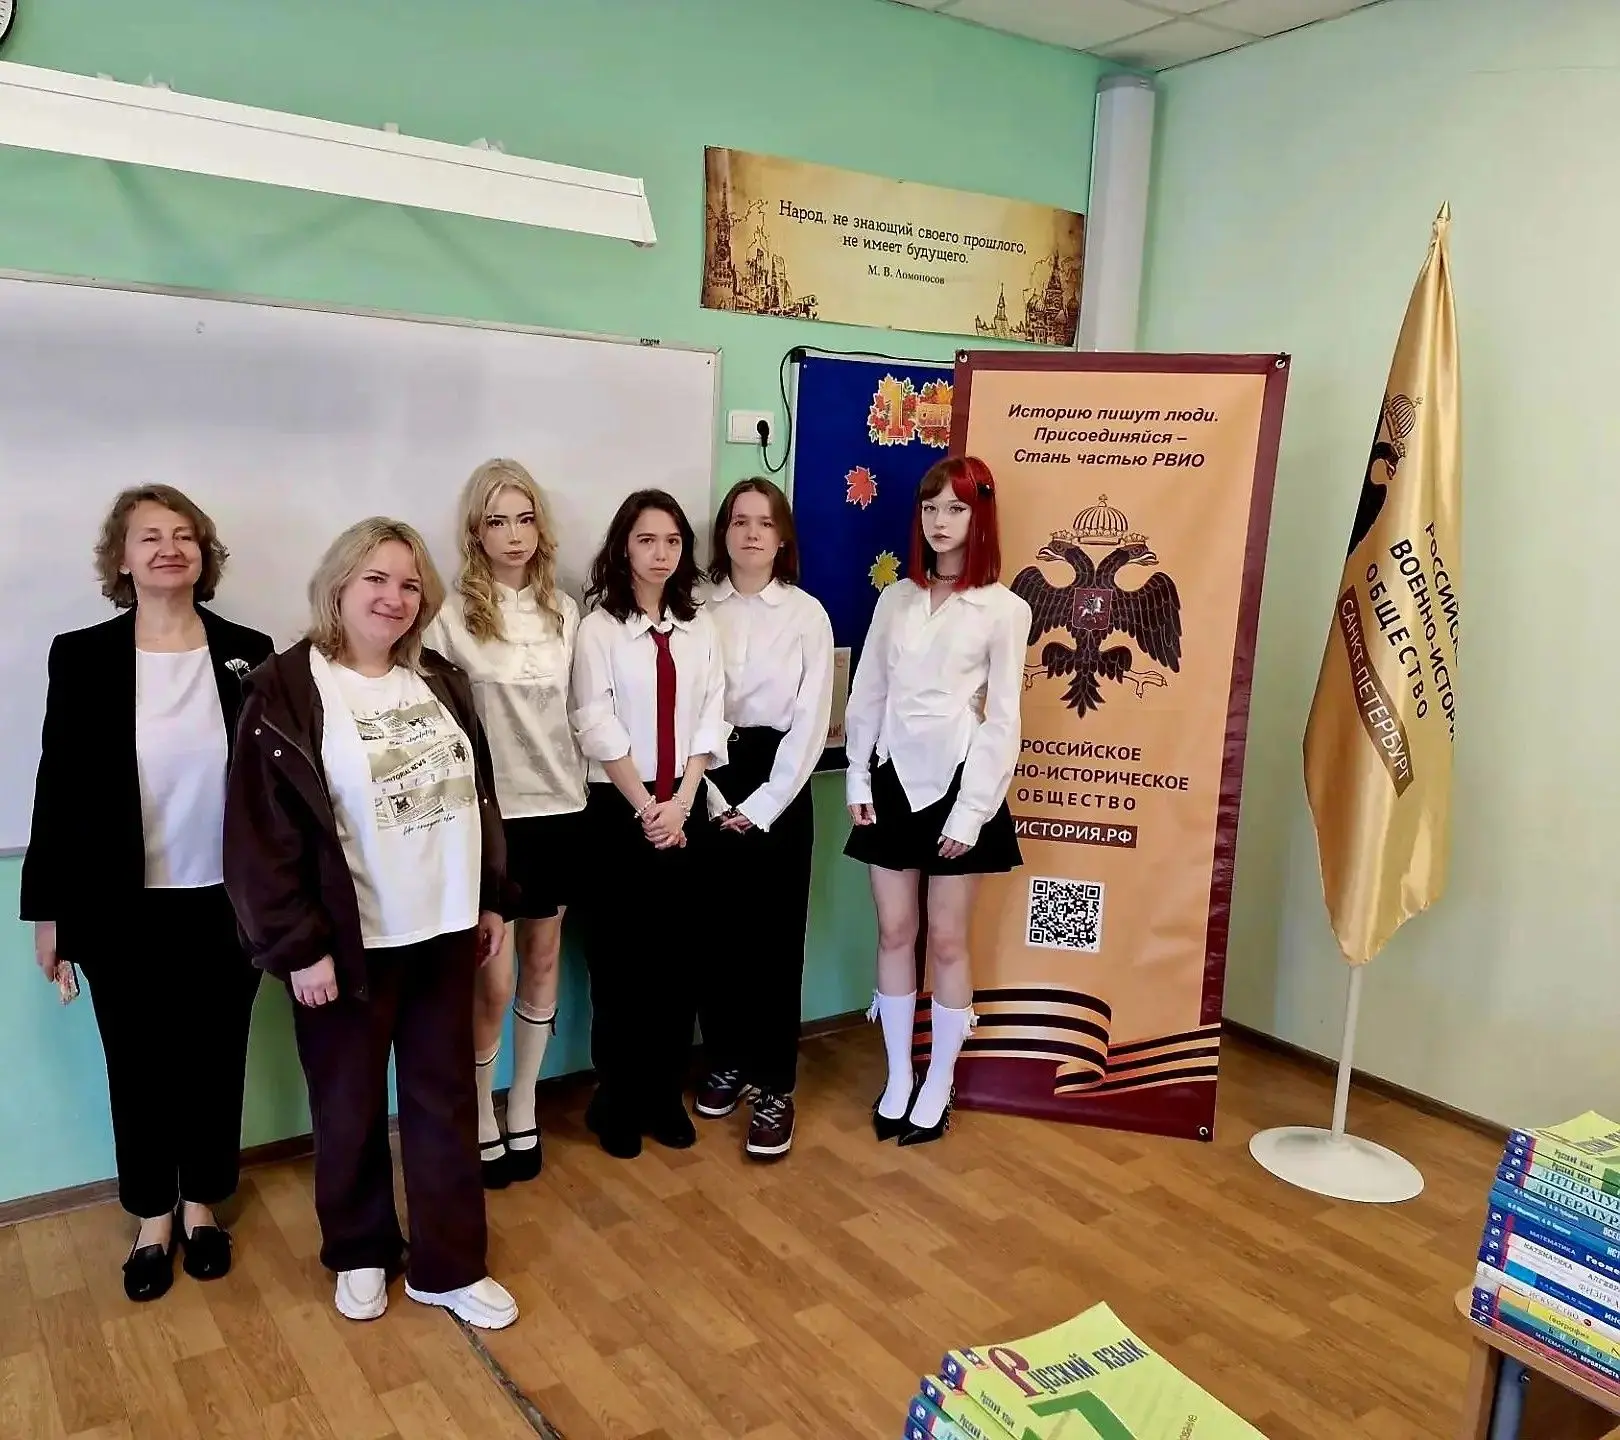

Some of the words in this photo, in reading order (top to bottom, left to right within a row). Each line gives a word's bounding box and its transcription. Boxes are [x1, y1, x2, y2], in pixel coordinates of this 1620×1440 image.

[779, 200, 827, 226] Народ,
[833, 214, 848, 226] не
[853, 218, 913, 239] знающий
[918, 229, 959, 245] своего
[843, 236, 858, 248] не
[863, 240, 902, 256] имеет
[907, 245, 969, 265] будущего.
[868, 264, 881, 277] М.
[884, 267, 893, 278] В.
[896, 270, 945, 286] Ломоносов
[1008, 404, 1092, 421] Историю
[1098, 407, 1160, 423] пишут
[1164, 407, 1219, 424] люди.
[1034, 426, 1173, 445] Присоединяйся
[1014, 449, 1071, 465] Стань
[1077, 453, 1147, 467] частью
[1152, 453, 1205, 468] РВИО
[1425, 521, 1459, 668] РОССИЙС
[1366, 563, 1428, 719] ОБЩЕСТВО
[1390, 539, 1455, 742] ВОЕННО-ИСТОР
[1341, 599, 1410, 779] САНКТ-ПЕТЕРБУРГ
[1020, 739, 1142, 761] РОССИЙСКОЕ
[1014, 763, 1189, 791] НО-ИСТОРИЧЕСКОЕ
[1016, 788, 1136, 811] ОБЩЕСТВО
[1014, 820, 1133, 844] ИСТОРИЯ.РФ
[1535, 1183, 1620, 1227] ЛИТЕРАТУР
[1523, 1242, 1573, 1270] МАТЕМАТИКА
[1588, 1273, 1620, 1292] АЛГЕБР
[1529, 1230, 1576, 1255] МАТЕМАТИКА
[1586, 1254, 1620, 1275] Геоме
[1535, 1332, 1578, 1358] МАТЕМАТИКА
[988, 1347, 1100, 1397] Русский
